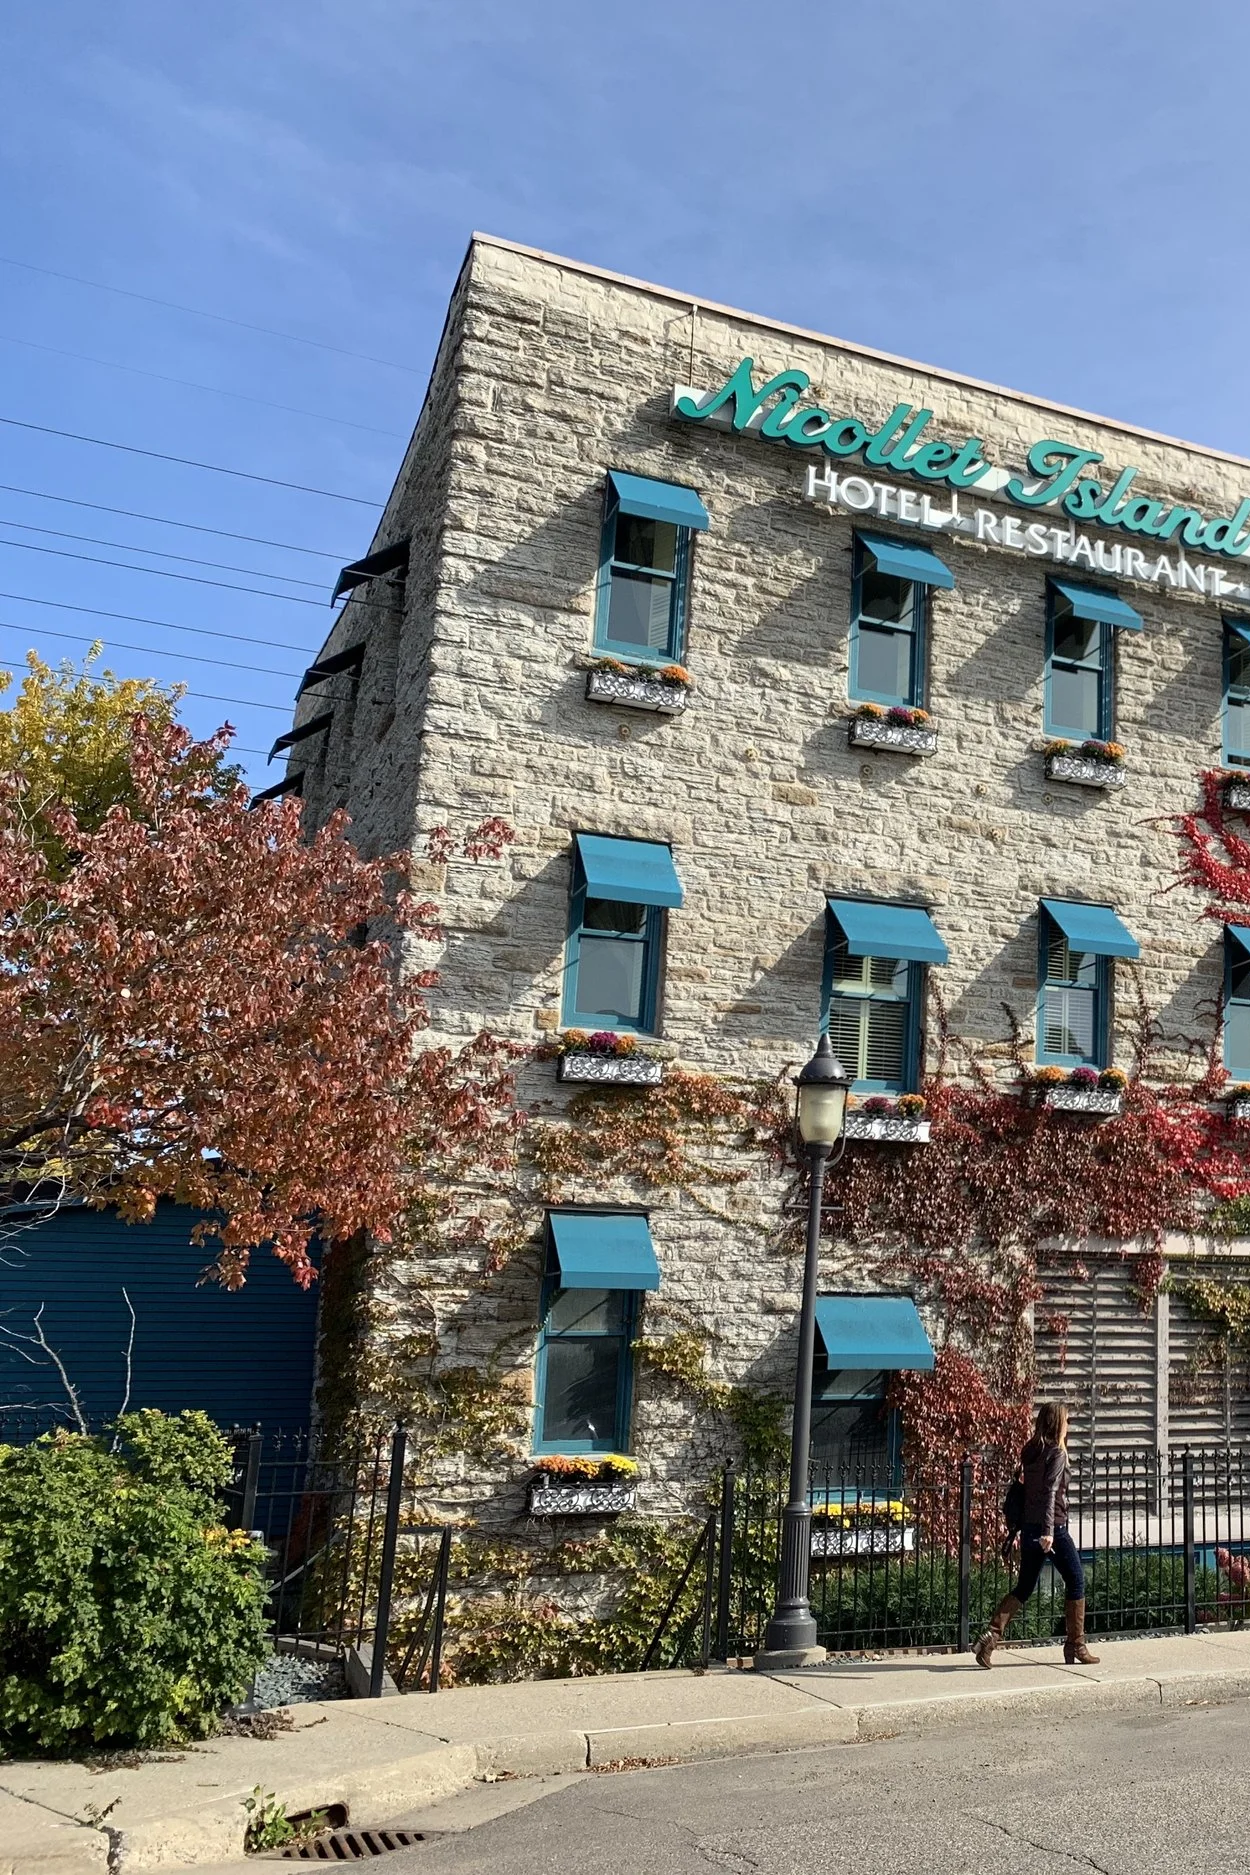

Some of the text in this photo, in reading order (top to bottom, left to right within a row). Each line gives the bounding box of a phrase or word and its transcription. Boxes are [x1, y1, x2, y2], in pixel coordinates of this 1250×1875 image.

[674, 357, 991, 488] Nicollet
[806, 465, 942, 528] HOTEL
[975, 509, 1227, 596] RESTAURANT
